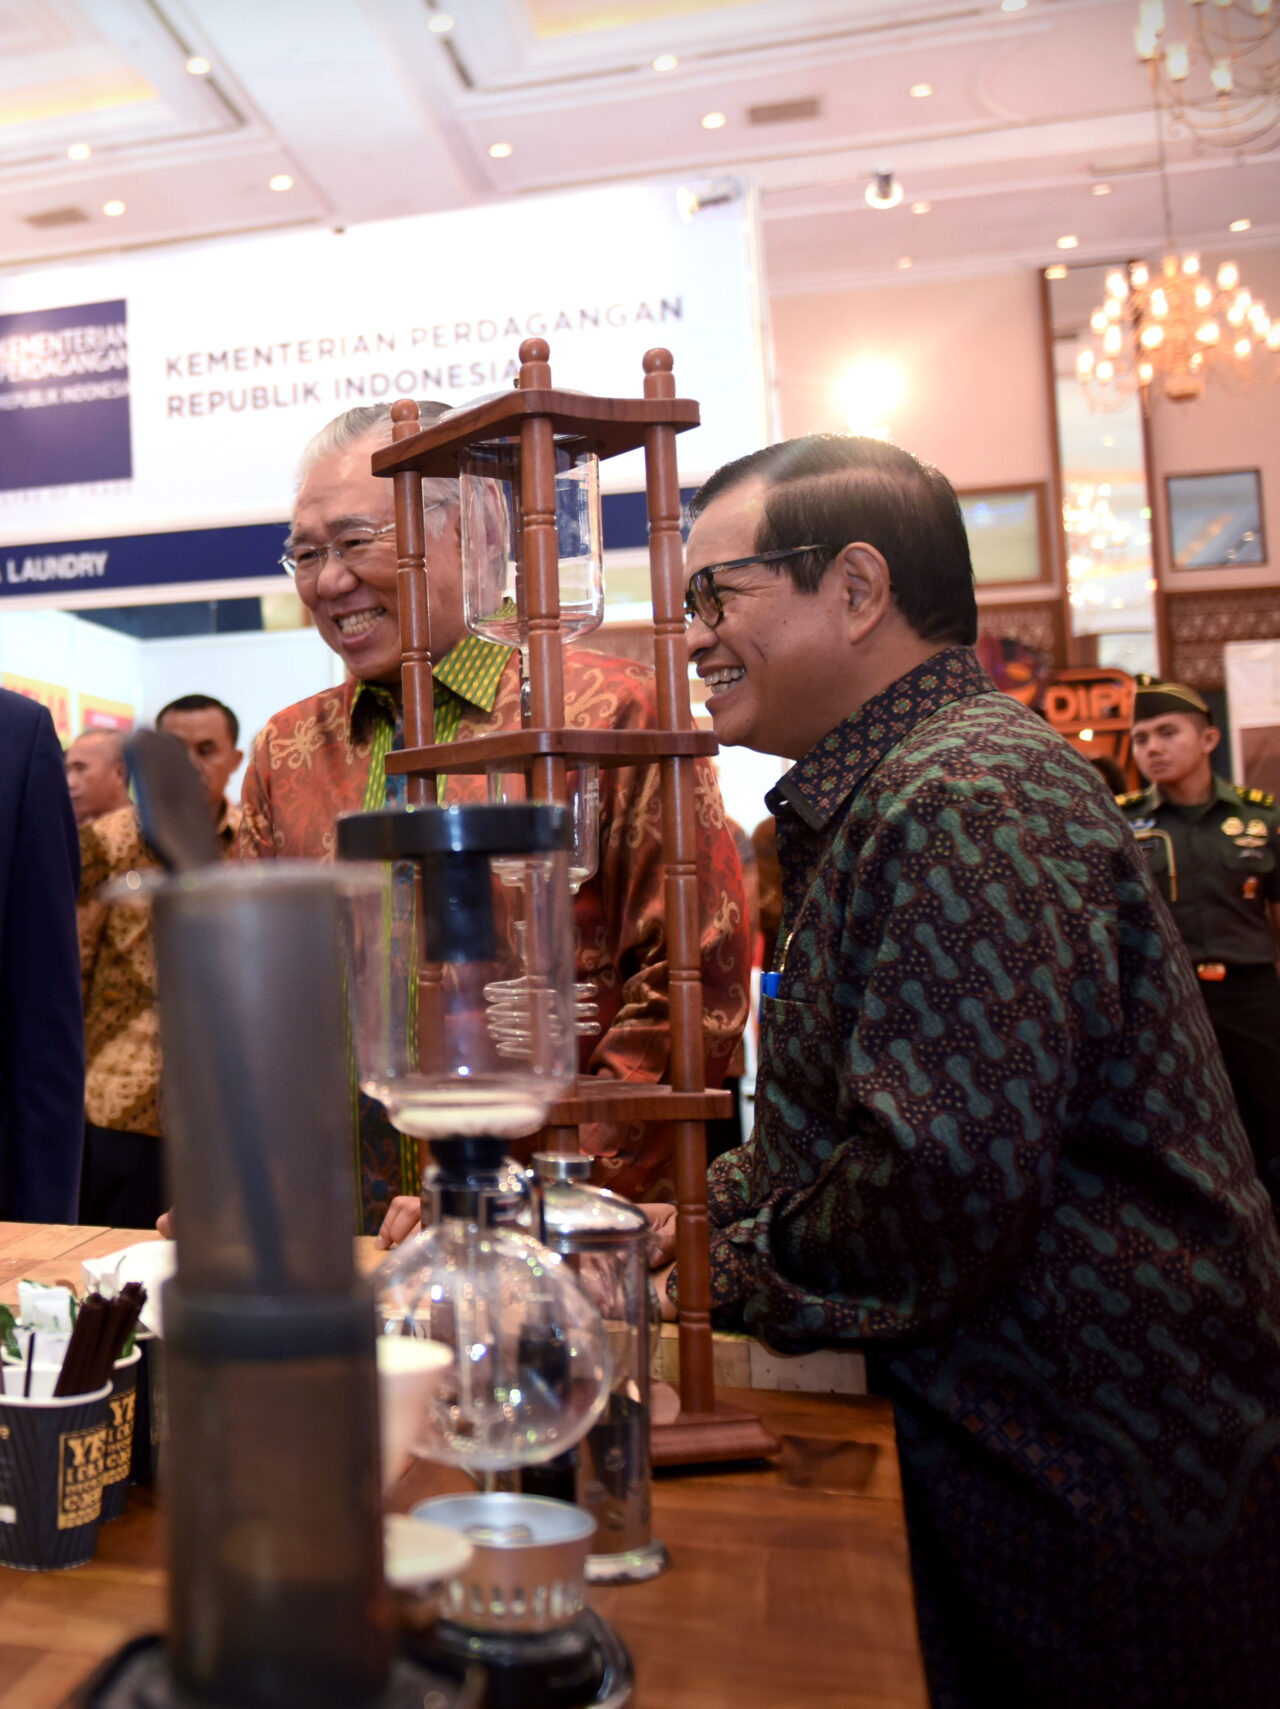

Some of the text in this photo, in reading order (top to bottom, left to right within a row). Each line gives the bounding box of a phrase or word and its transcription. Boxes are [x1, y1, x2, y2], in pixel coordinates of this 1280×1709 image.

[166, 297, 683, 378] KEMENTERIAN PERDAGANGAN
[167, 358, 521, 418] REPUBLIK INDONESIA
[7, 552, 108, 583] LAUNDRY
